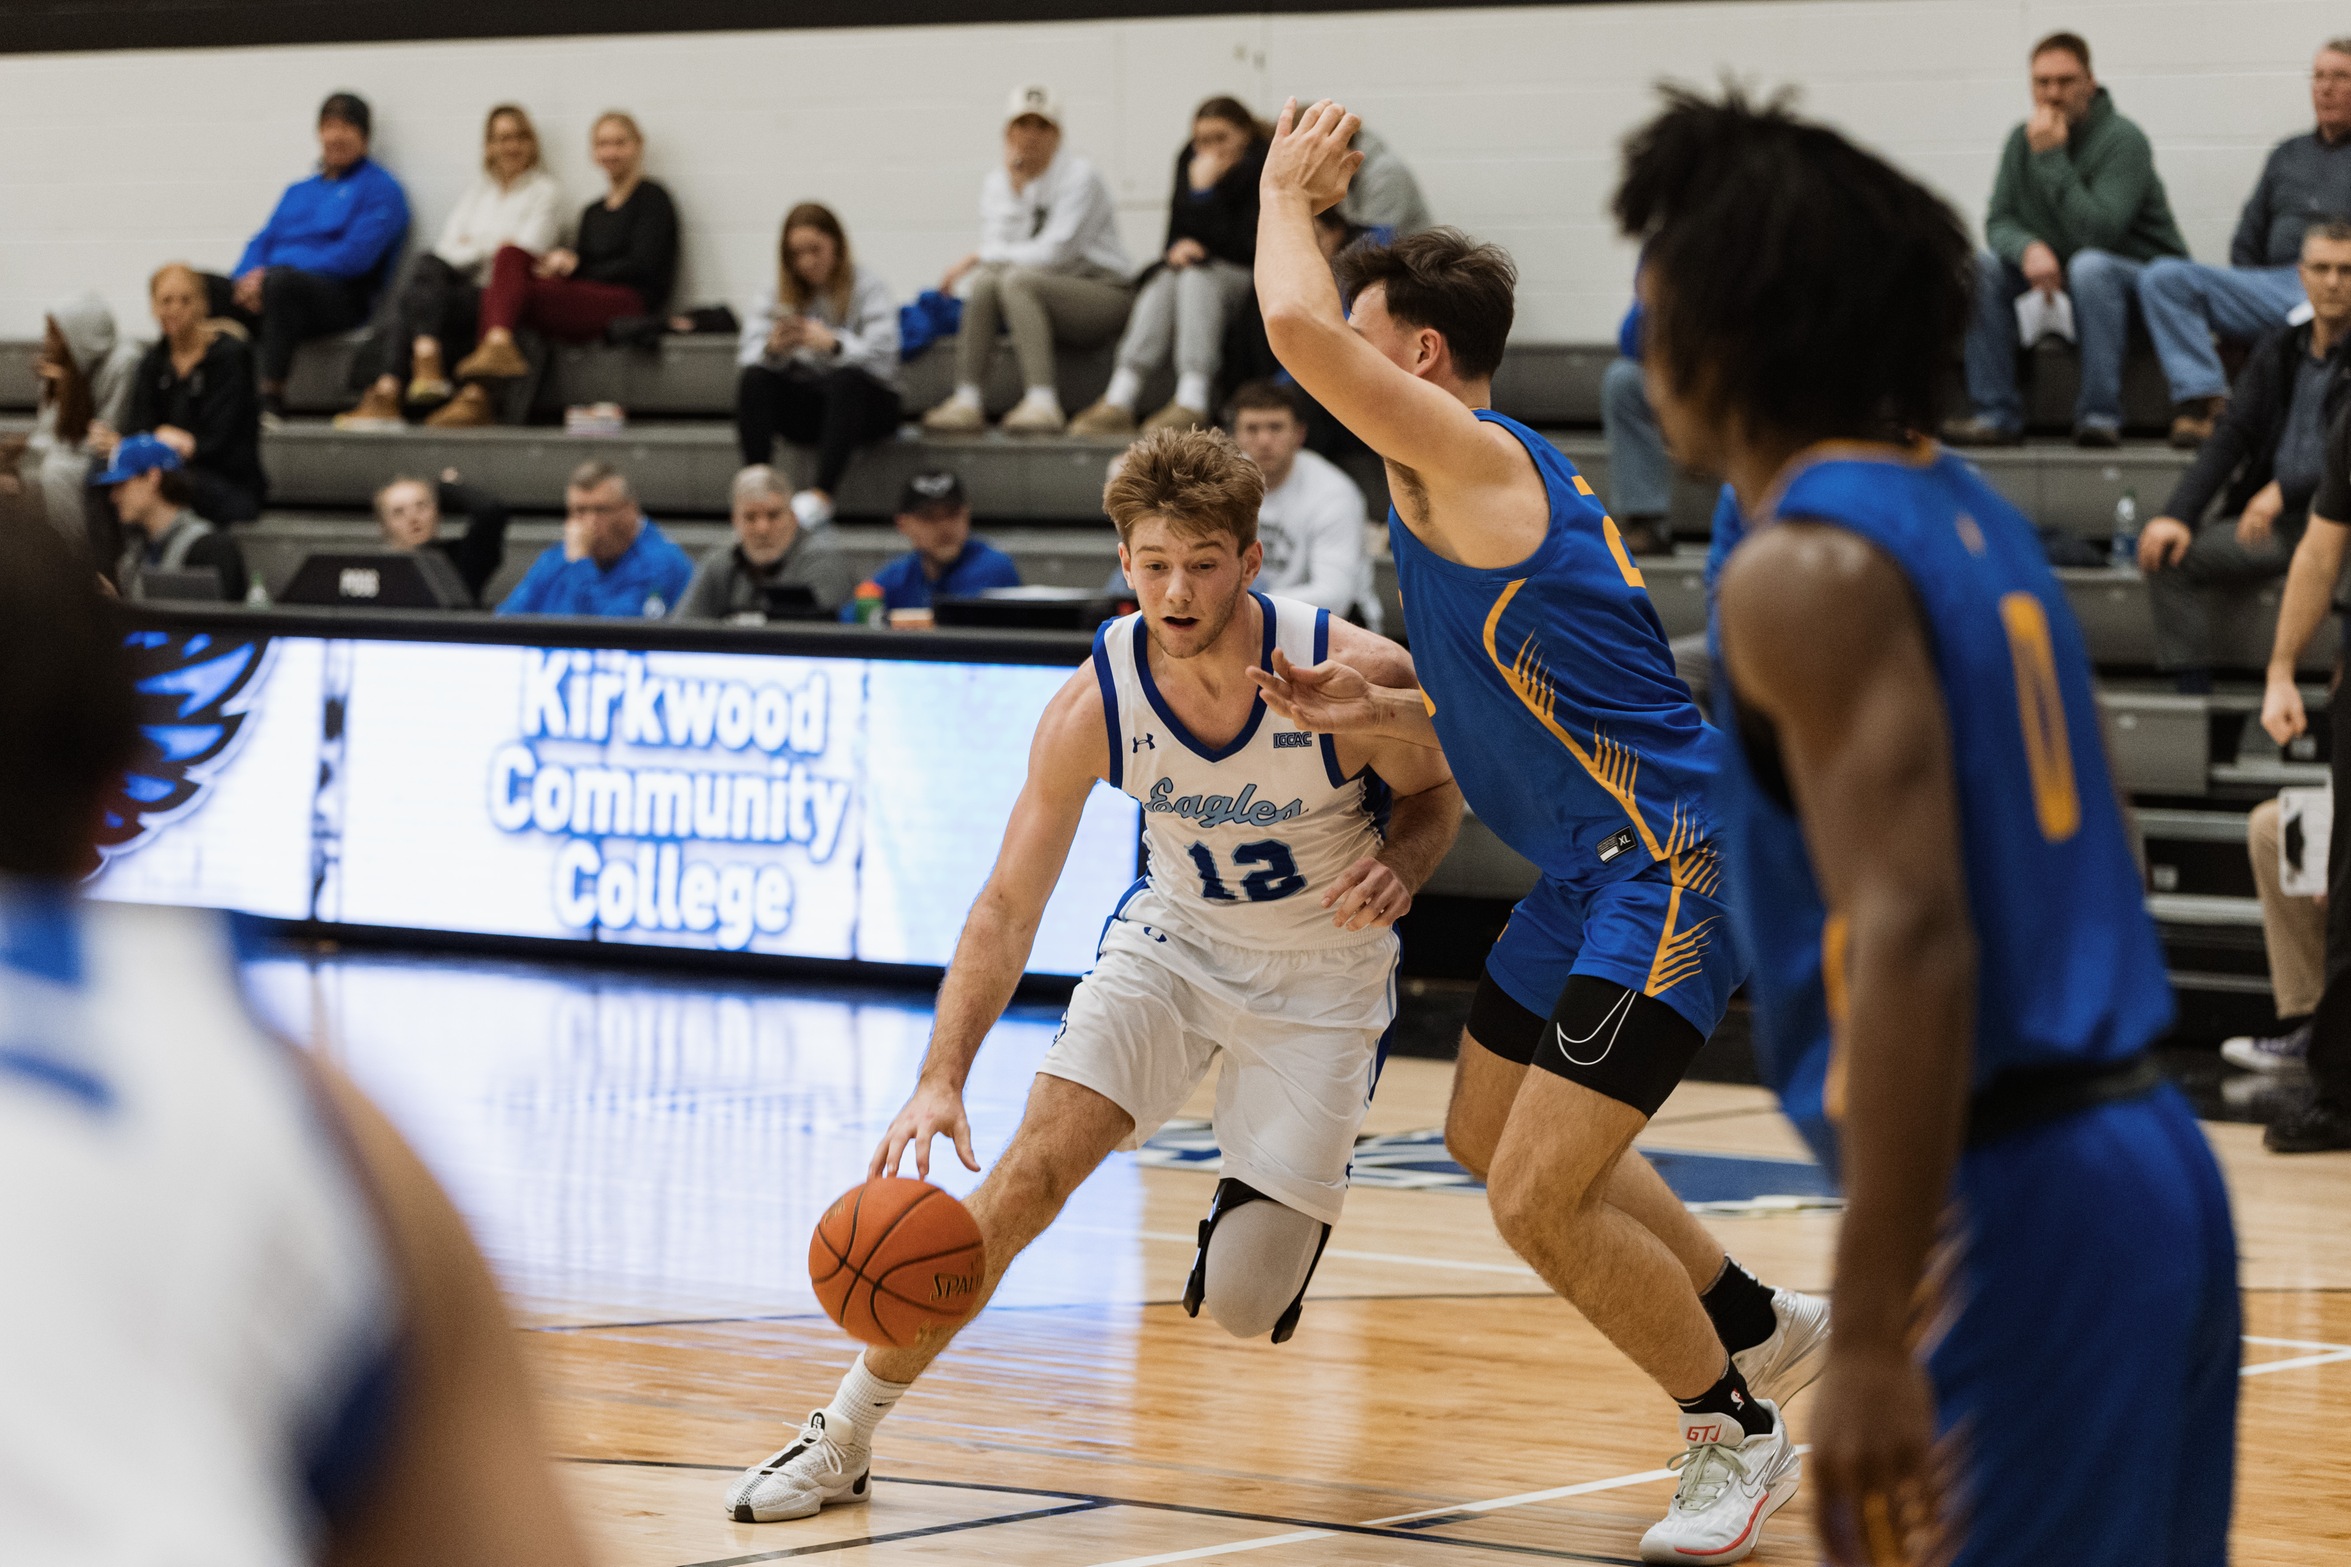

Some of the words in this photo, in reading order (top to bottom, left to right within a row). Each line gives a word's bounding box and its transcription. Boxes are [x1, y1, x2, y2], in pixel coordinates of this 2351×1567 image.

[521, 647, 828, 754] Kirkwood
[1272, 731, 1312, 749] ICCAC
[490, 743, 851, 862] Community
[1144, 776, 1309, 828] Eagles
[1183, 838, 1308, 902] 12
[1618, 834, 1632, 847] XL
[555, 839, 794, 950] College
